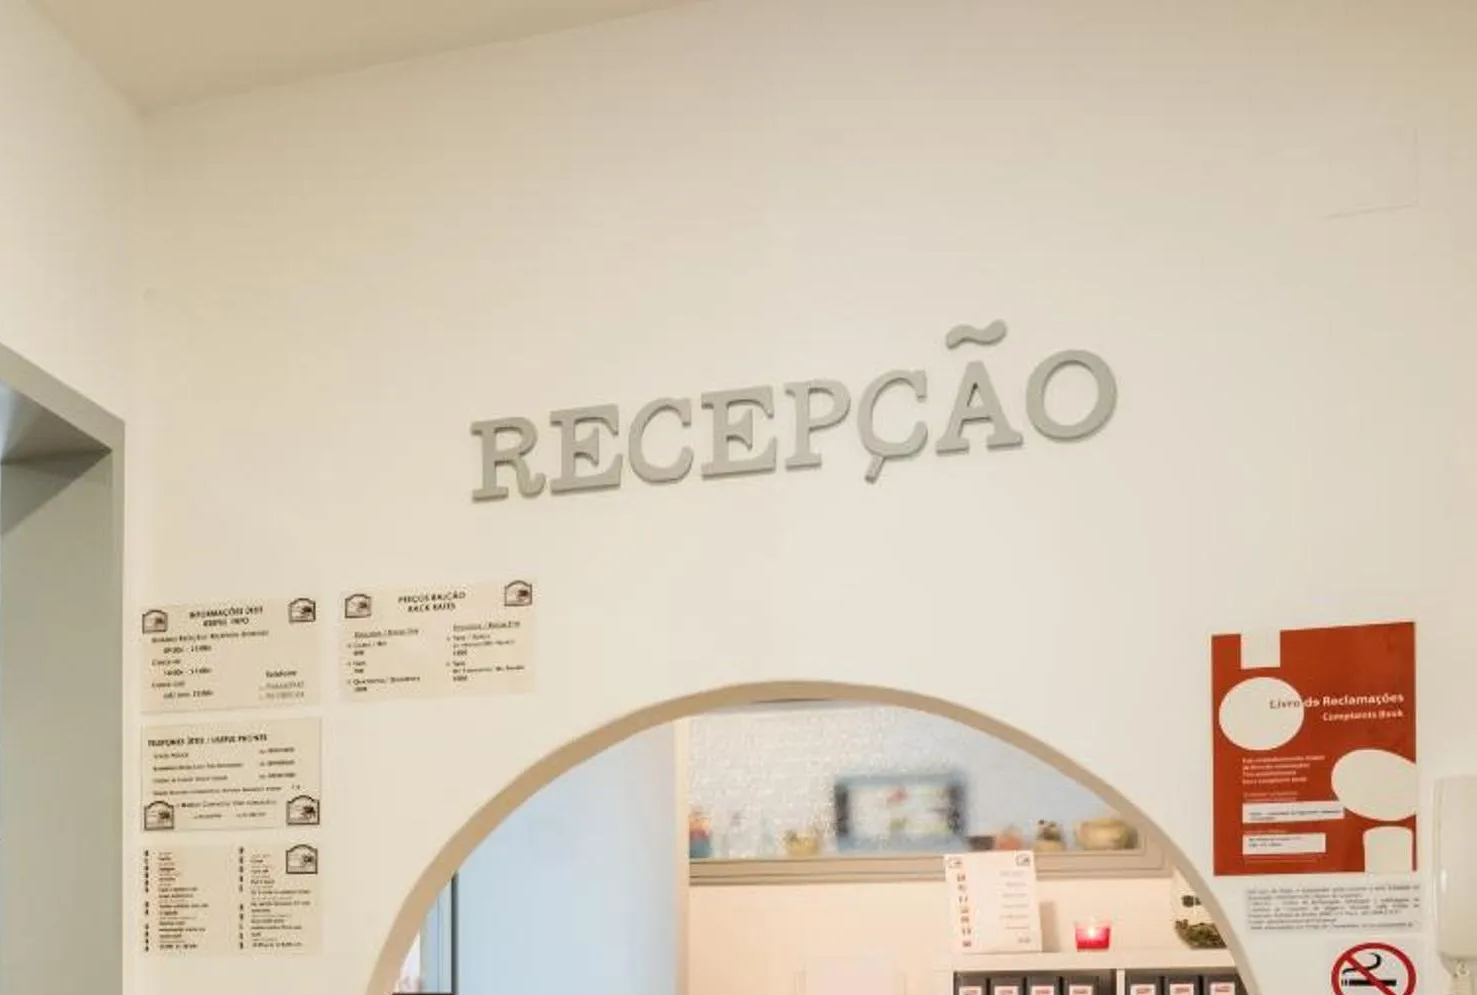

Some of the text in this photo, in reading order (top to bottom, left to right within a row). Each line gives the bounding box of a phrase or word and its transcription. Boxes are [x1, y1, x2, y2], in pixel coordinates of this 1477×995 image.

[470, 319, 1118, 503] RECEPÇÃO
[1268, 698, 1301, 710] Livro
[1322, 692, 1404, 706] Reclamações
